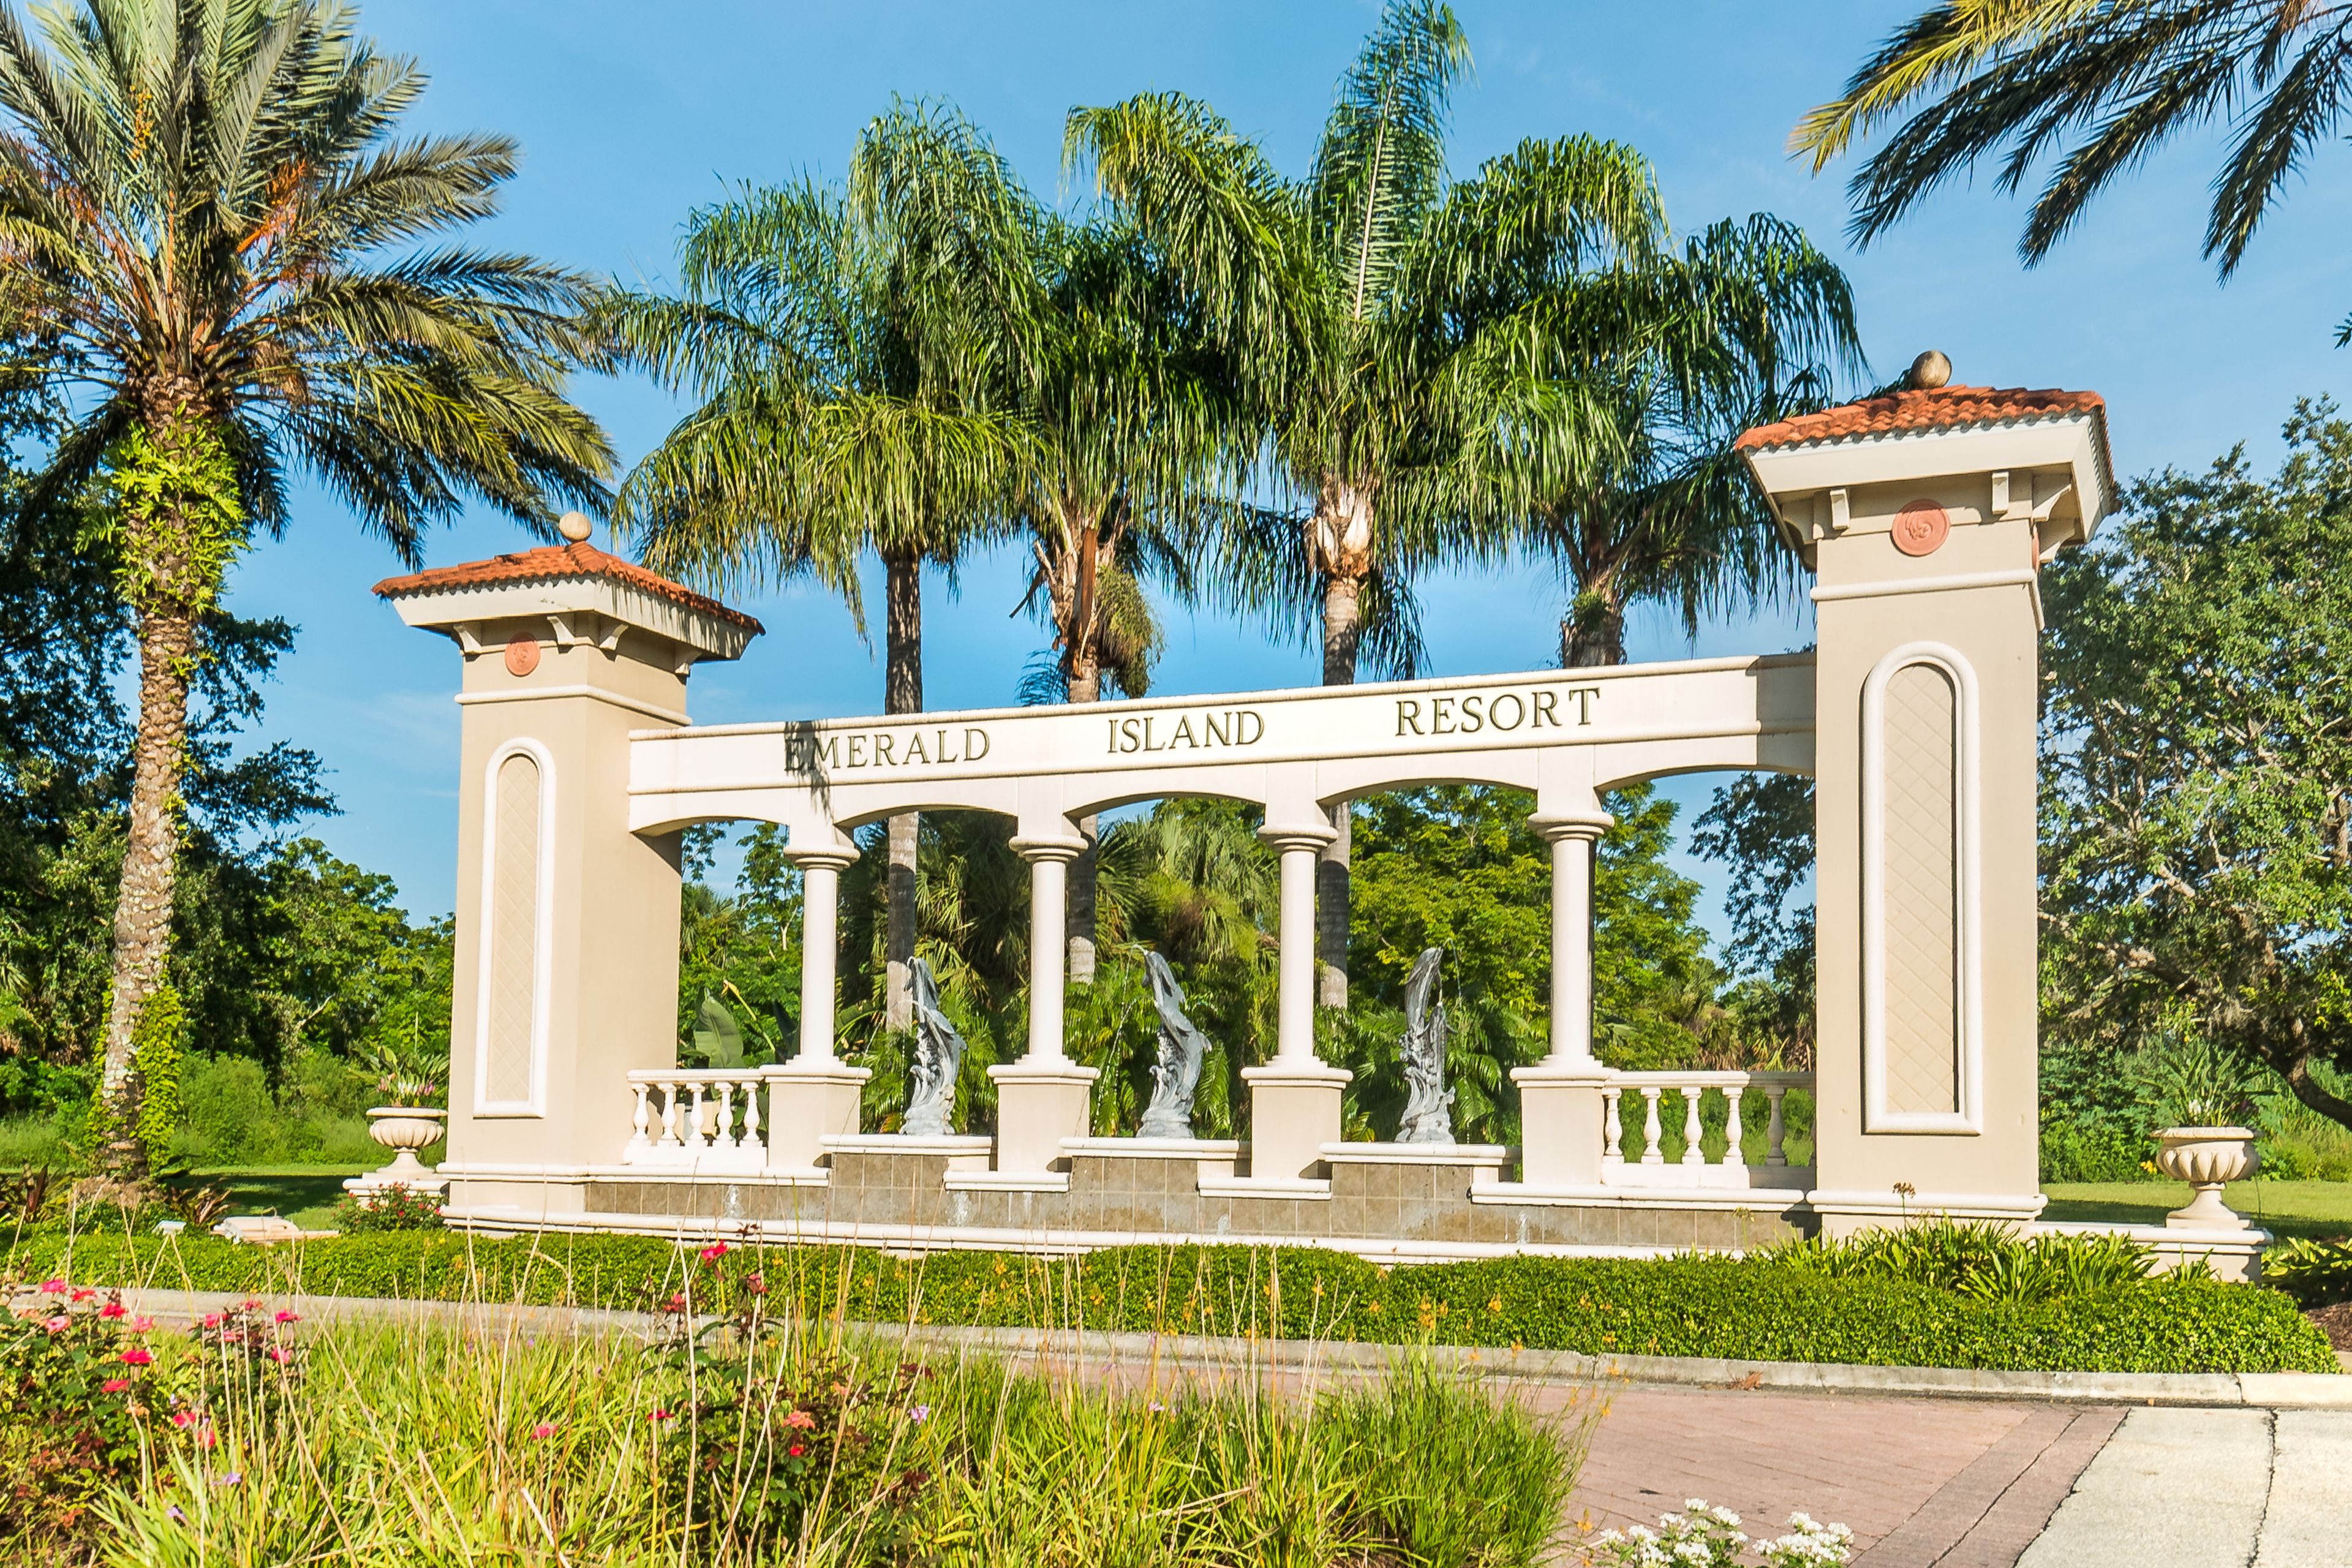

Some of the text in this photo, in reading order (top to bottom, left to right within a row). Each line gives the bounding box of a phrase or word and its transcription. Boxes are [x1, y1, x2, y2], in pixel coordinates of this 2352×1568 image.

[785, 687, 1600, 771] EMERALD ISLAND RESORT
